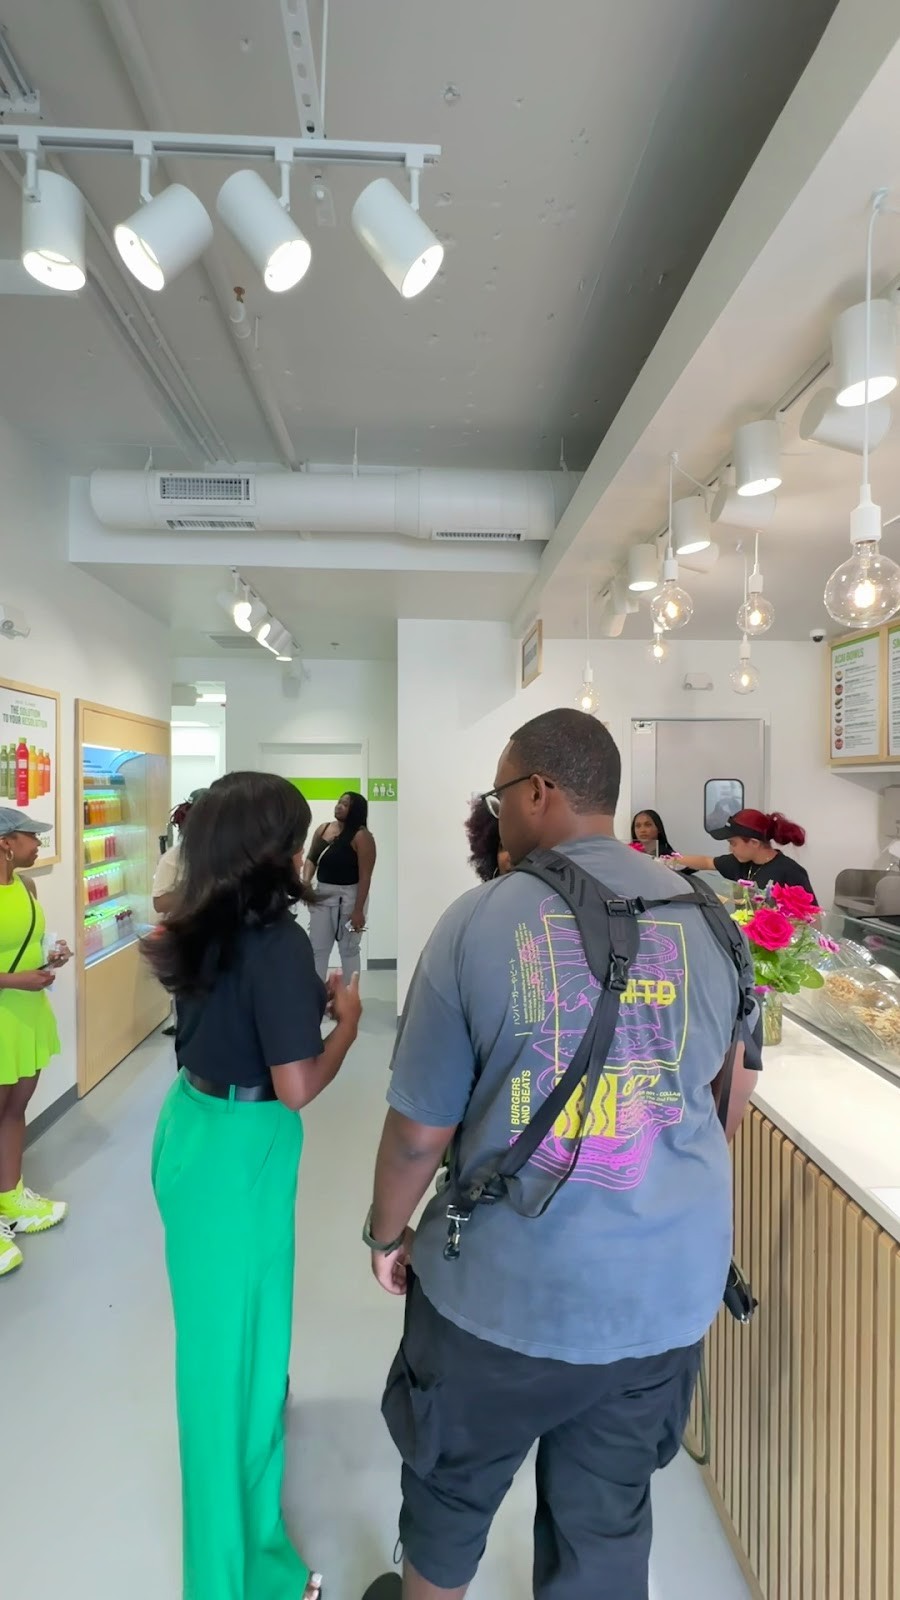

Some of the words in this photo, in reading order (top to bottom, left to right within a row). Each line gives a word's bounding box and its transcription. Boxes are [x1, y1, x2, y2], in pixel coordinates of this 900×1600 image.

[846, 648, 864, 661] BOWLS
[11, 704, 19, 715] THE
[20, 706, 41, 718] SOLUTION
[2, 713, 9, 723] TO
[9, 714, 21, 724] YOUR
[21, 716, 48, 728] RESOLUTION
[521, 1070, 531, 1103] BEATS
[511, 1076, 521, 1125] BURGERS
[521, 1105, 530, 1125] AND
